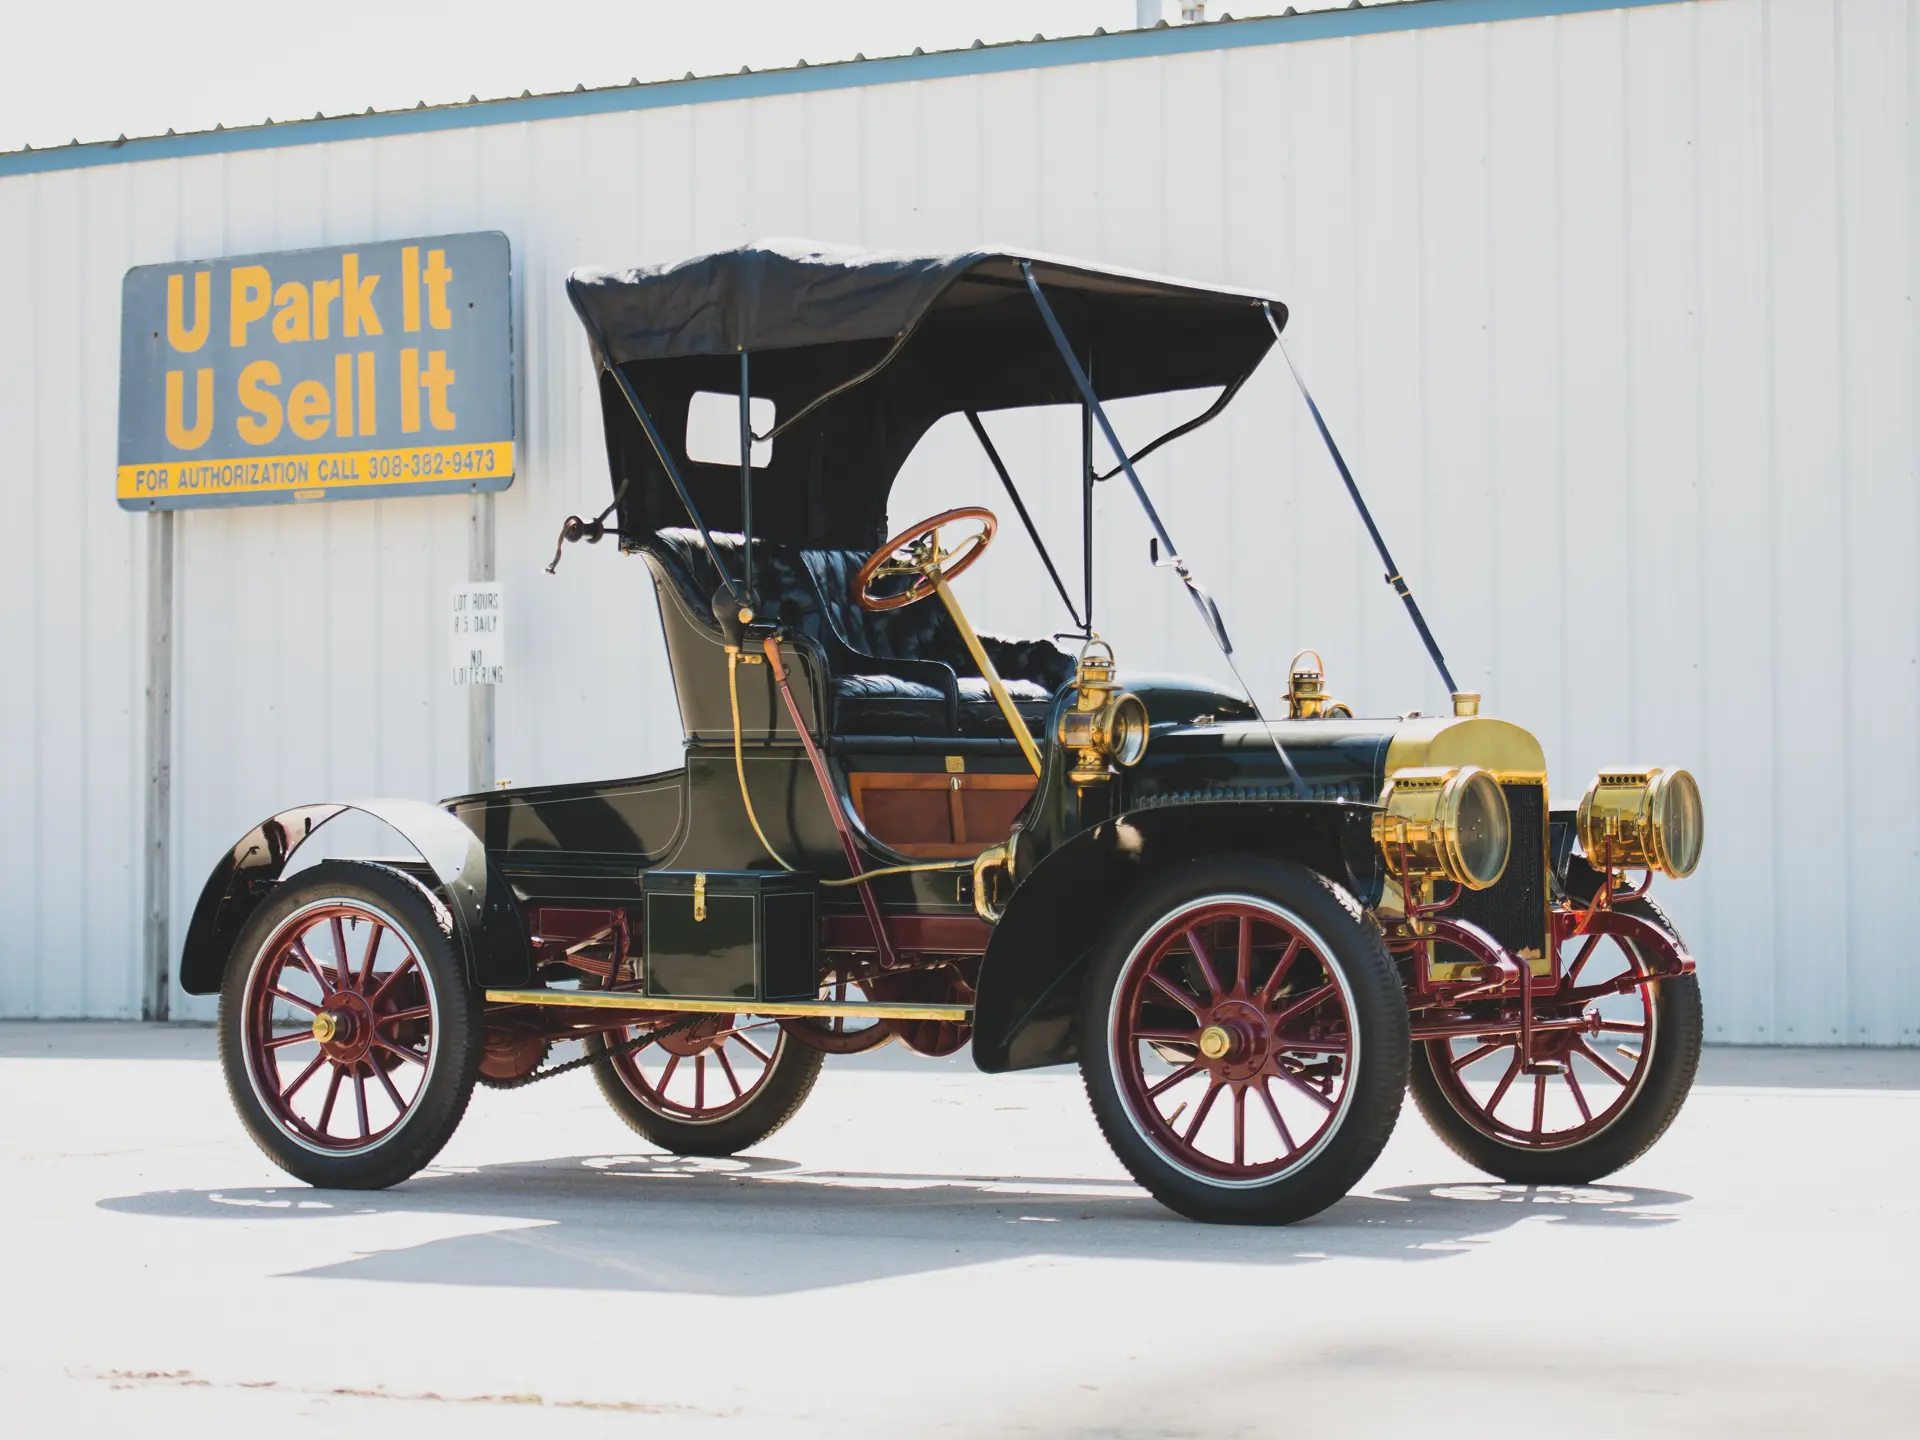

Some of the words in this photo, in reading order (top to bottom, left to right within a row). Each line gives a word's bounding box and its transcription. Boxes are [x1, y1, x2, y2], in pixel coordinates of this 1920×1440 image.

[167, 272, 211, 352] U
[230, 254, 383, 347] Park
[401, 246, 453, 333] It
[165, 368, 214, 451] U
[237, 352, 376, 446] Sell
[400, 348, 456, 434] It
[136, 468, 169, 492] FOR
[178, 460, 309, 490] AUTHORIZATION
[317, 457, 359, 481] CALL
[368, 449, 495, 480] 308-382-9473
[454, 594, 467, 612] LOT
[472, 593, 498, 611] HOURS
[474, 615, 497, 632] DAILY
[470, 650, 482, 667] NO
[453, 666, 503, 685] LOITERING
